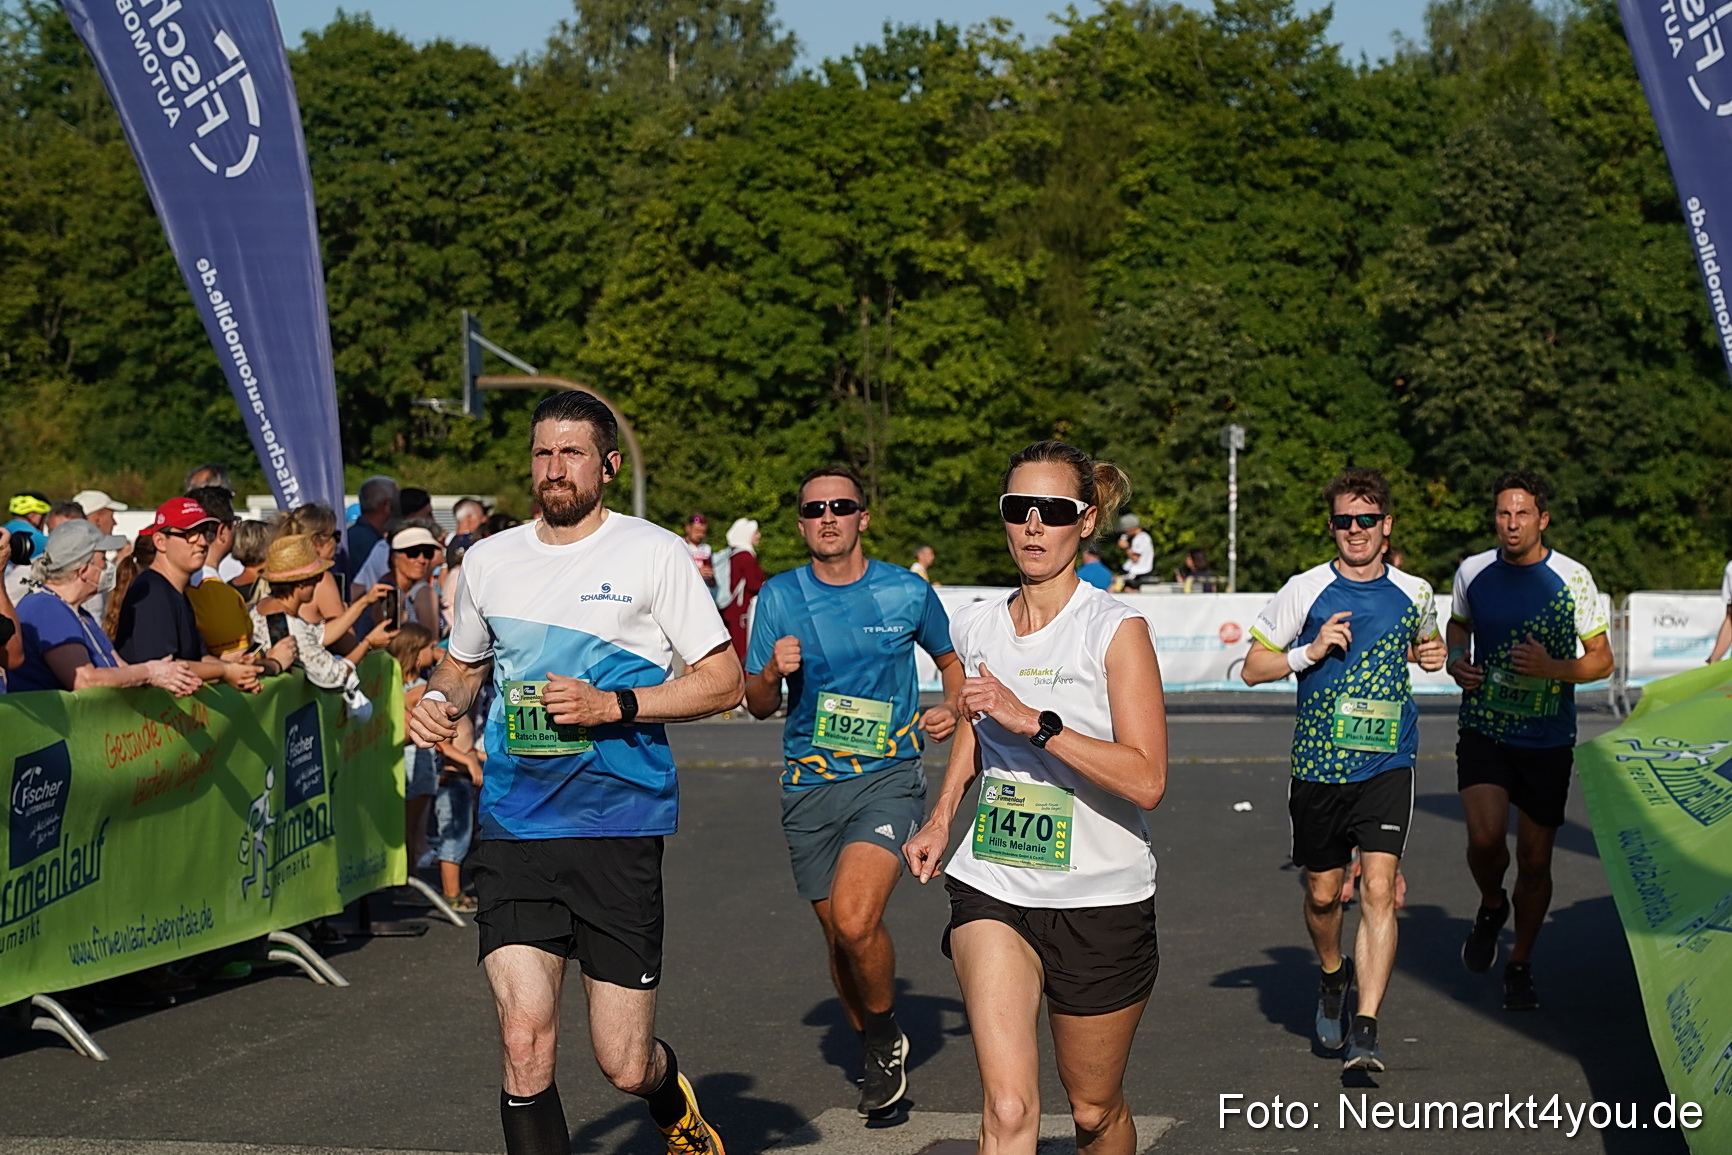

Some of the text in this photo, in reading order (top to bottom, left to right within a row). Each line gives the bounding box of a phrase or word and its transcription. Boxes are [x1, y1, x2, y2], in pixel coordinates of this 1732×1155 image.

[875, 625, 904, 633] PLAST
[1498, 685, 1531, 702] 847
[508, 714, 517, 740] RUN
[516, 732, 538, 741] Ratsch
[817, 716, 827, 737] RUN
[828, 713, 879, 738] 1927
[876, 724, 887, 751] 2022
[1352, 716, 1386, 735] 712
[105, 711, 162, 769] Gesunde
[21, 779, 63, 808] Fischer
[977, 813, 987, 843] RUN
[988, 806, 1054, 842] 1470
[988, 836, 1047, 854] Hills Melanie
[1054, 820, 1067, 860] 2022
